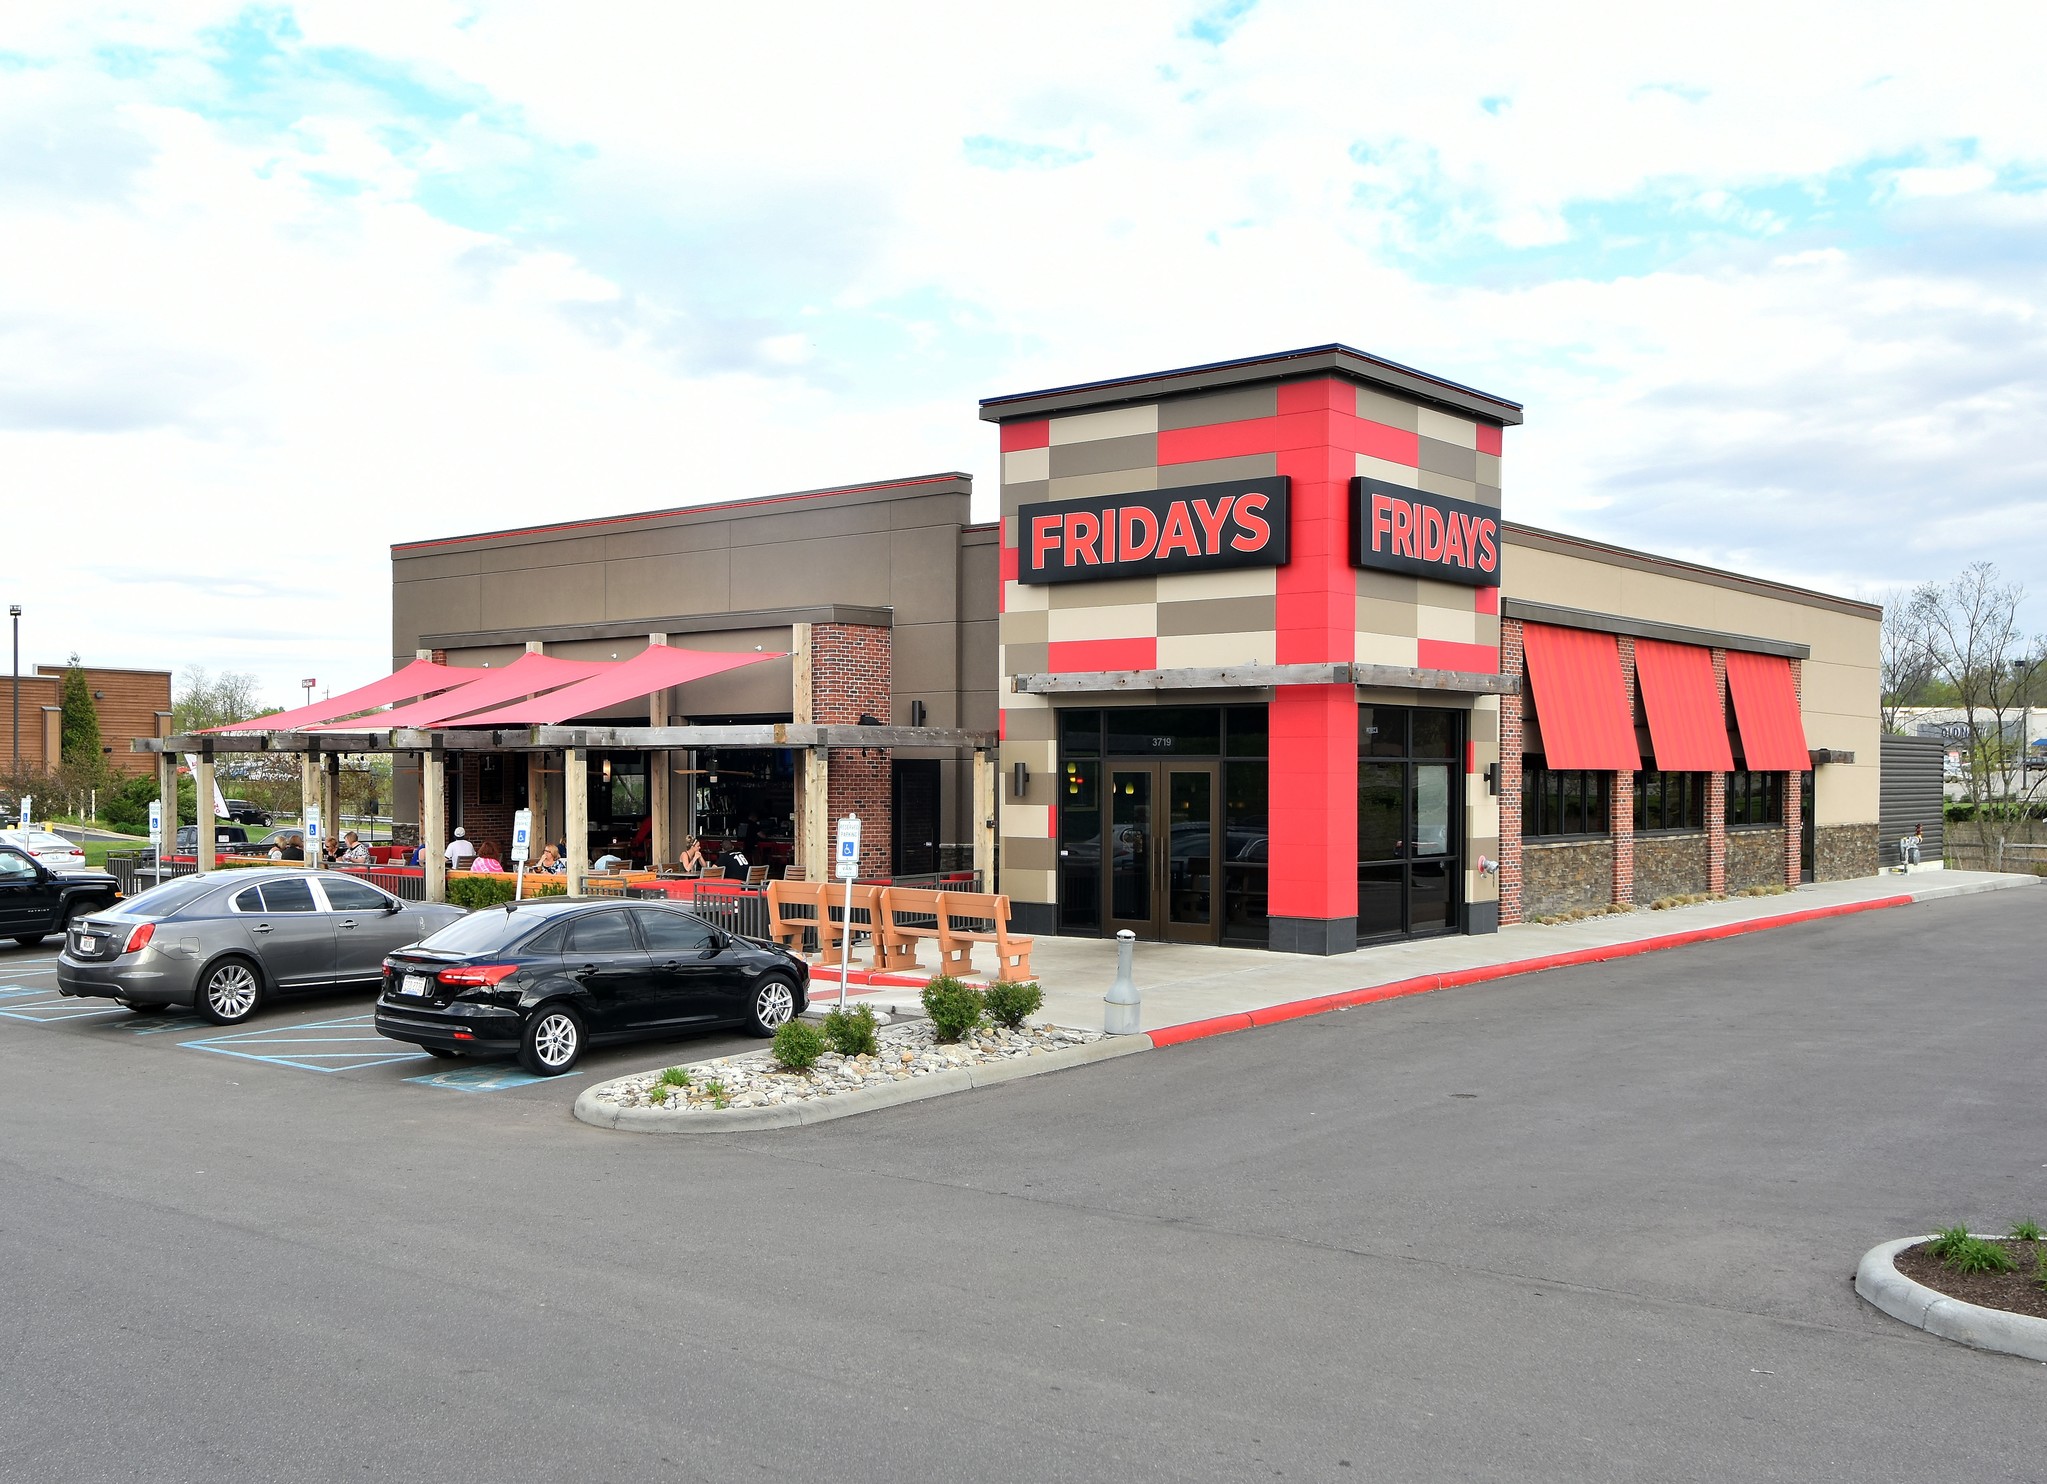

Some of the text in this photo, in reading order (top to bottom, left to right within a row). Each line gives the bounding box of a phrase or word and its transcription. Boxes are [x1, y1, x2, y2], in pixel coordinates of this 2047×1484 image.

[1031, 493, 1271, 570] FRIDAYS
[1371, 493, 1497, 573] FRIDAYS
[1152, 737, 1171, 746] 3719
